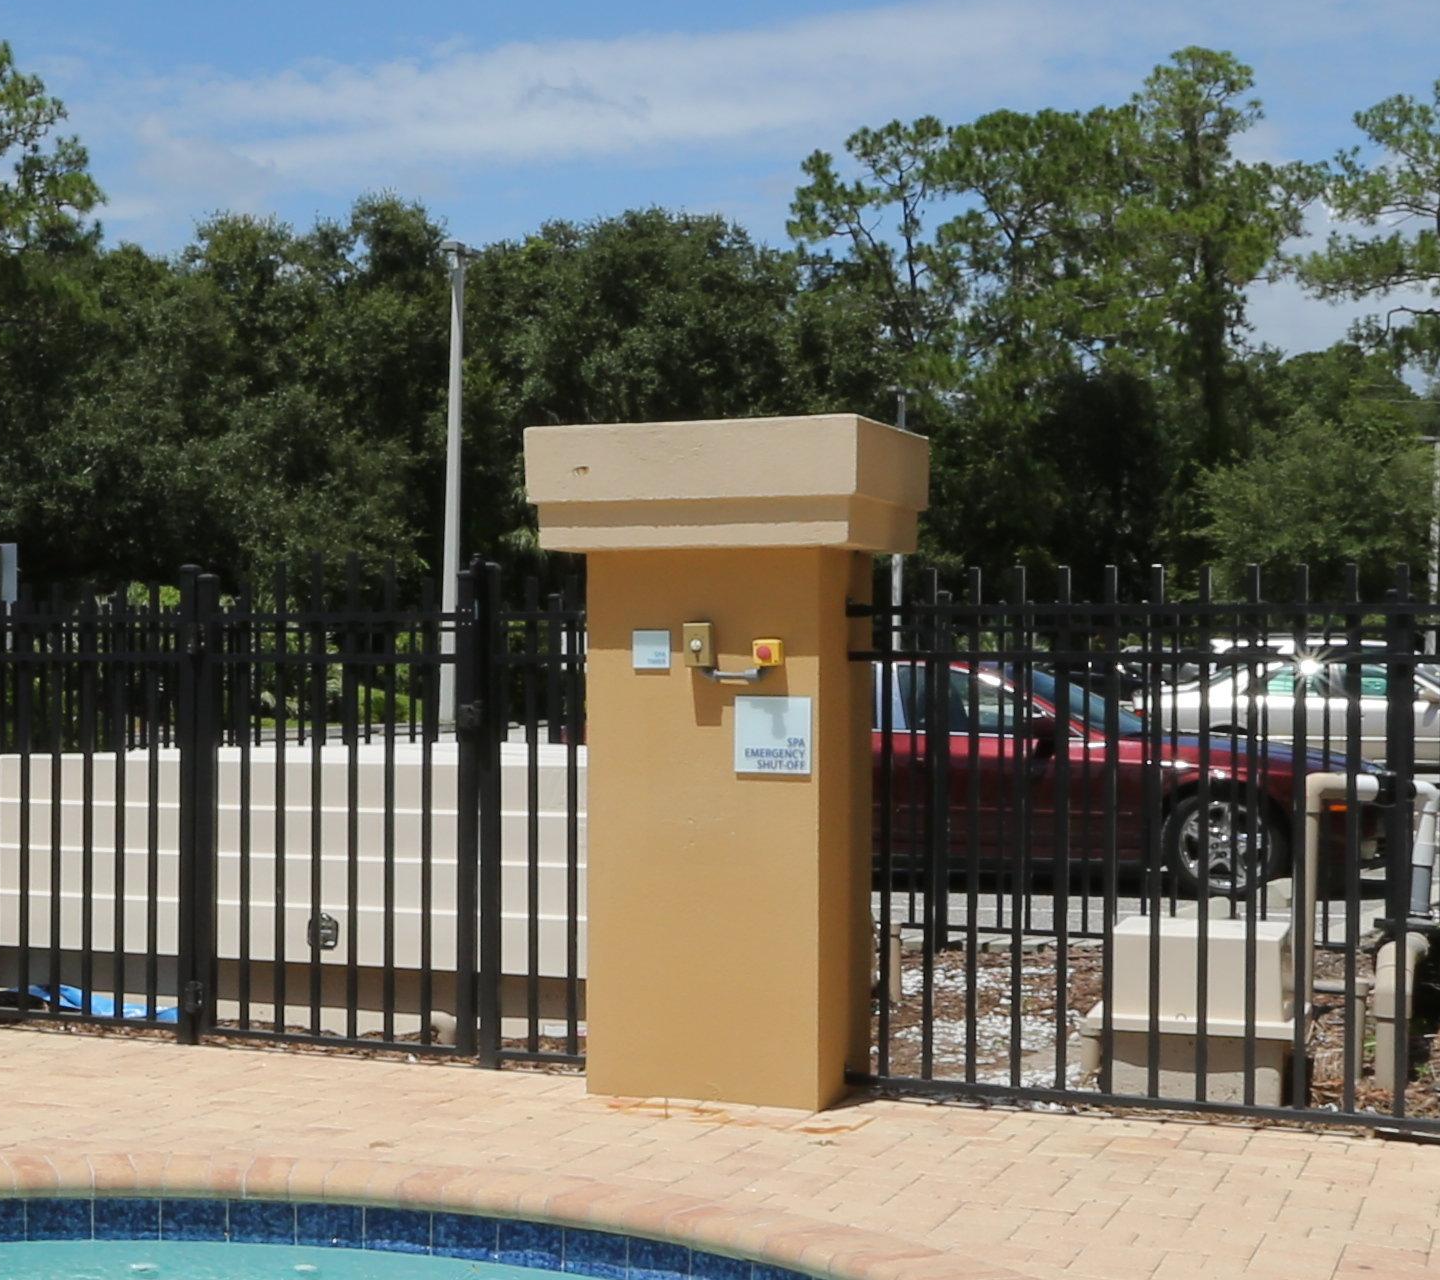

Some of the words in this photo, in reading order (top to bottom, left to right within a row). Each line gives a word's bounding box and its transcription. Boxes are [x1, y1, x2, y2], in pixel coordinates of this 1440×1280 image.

[787, 738, 805, 747] SPA
[745, 748, 804, 758] EMERGENCY
[757, 759, 804, 769] SHUT-OFF
